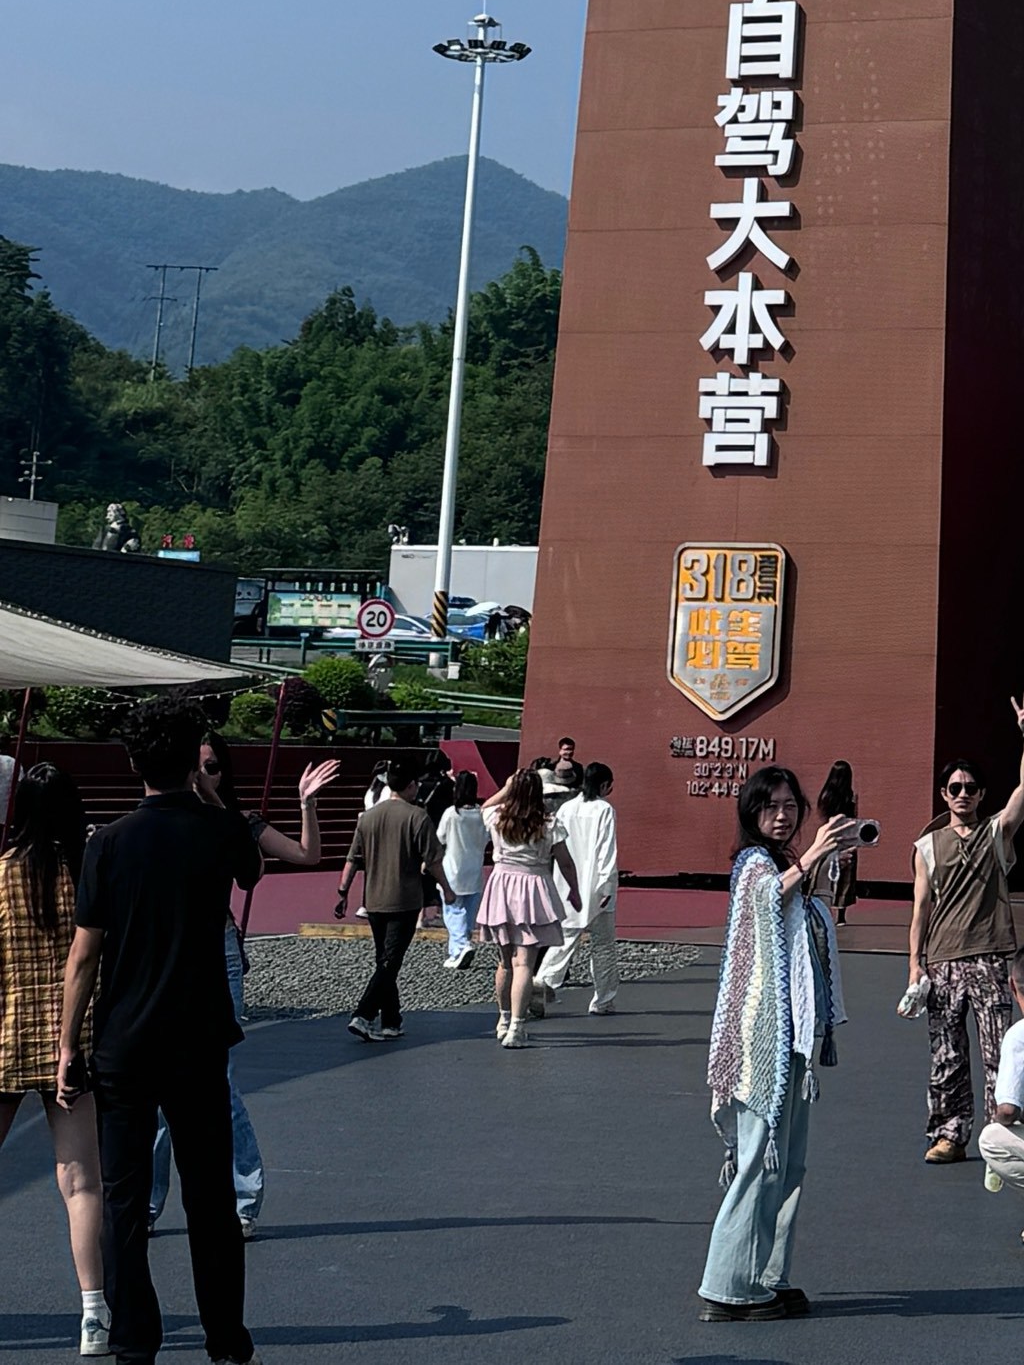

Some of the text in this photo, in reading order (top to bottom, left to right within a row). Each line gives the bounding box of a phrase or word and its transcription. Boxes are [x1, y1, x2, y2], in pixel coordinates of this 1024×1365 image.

[682, 553, 756, 601] 318
[366, 610, 387, 628] 20
[696, 736, 774, 759] 849.17M
